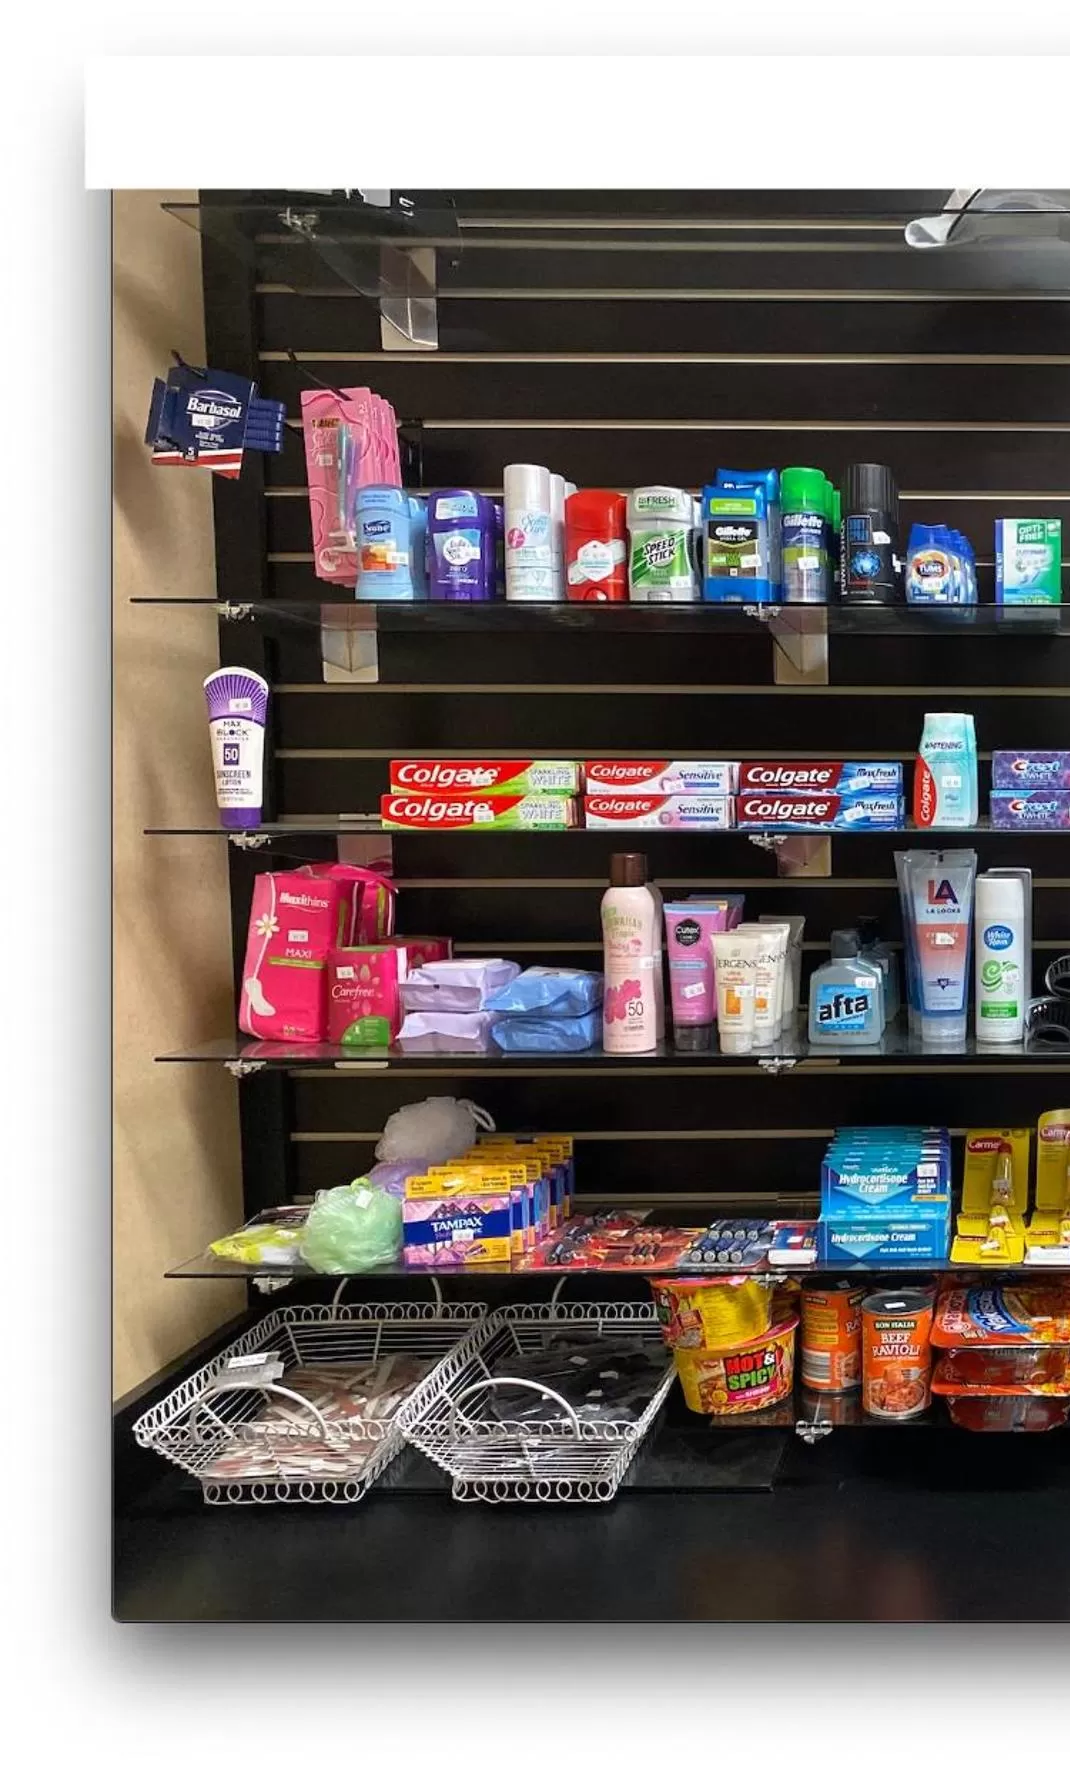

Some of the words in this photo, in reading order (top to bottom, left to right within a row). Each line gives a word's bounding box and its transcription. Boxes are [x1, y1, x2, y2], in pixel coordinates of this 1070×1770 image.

[187, 397, 242, 419] Barbasol
[644, 537, 675, 555] SPEED
[648, 549, 676, 565] STICK
[918, 564, 942, 573] TUMS
[224, 748, 239, 761] 50
[398, 765, 498, 787] Colgate
[590, 765, 652, 779] Colgate
[678, 770, 723, 780] Sensitive
[747, 767, 831, 787] Colgate
[921, 770, 932, 821] Colgate
[389, 798, 490, 821] Colgate
[588, 799, 652, 812] Colgate
[677, 804, 722, 814] Sensitive
[744, 800, 829, 819] Colgate
[676, 925, 700, 935] Cutex
[286, 948, 312, 959] MAXI
[331, 985, 375, 998] Carefree
[628, 1001, 644, 1016] 50
[818, 993, 869, 1022] afta
[968, 1140, 1001, 1149] Carme
[839, 1173, 908, 1185] Hydrocortisone
[859, 1184, 888, 1193] Cream
[431, 1216, 483, 1232] TAMPAX
[831, 1232, 890, 1244] Hydrocortisone
[891, 1232, 917, 1242] Cream
[880, 1332, 911, 1344] BEEF
[872, 1345, 921, 1357] RAVIOLI
[727, 1366, 776, 1390] SPICY
